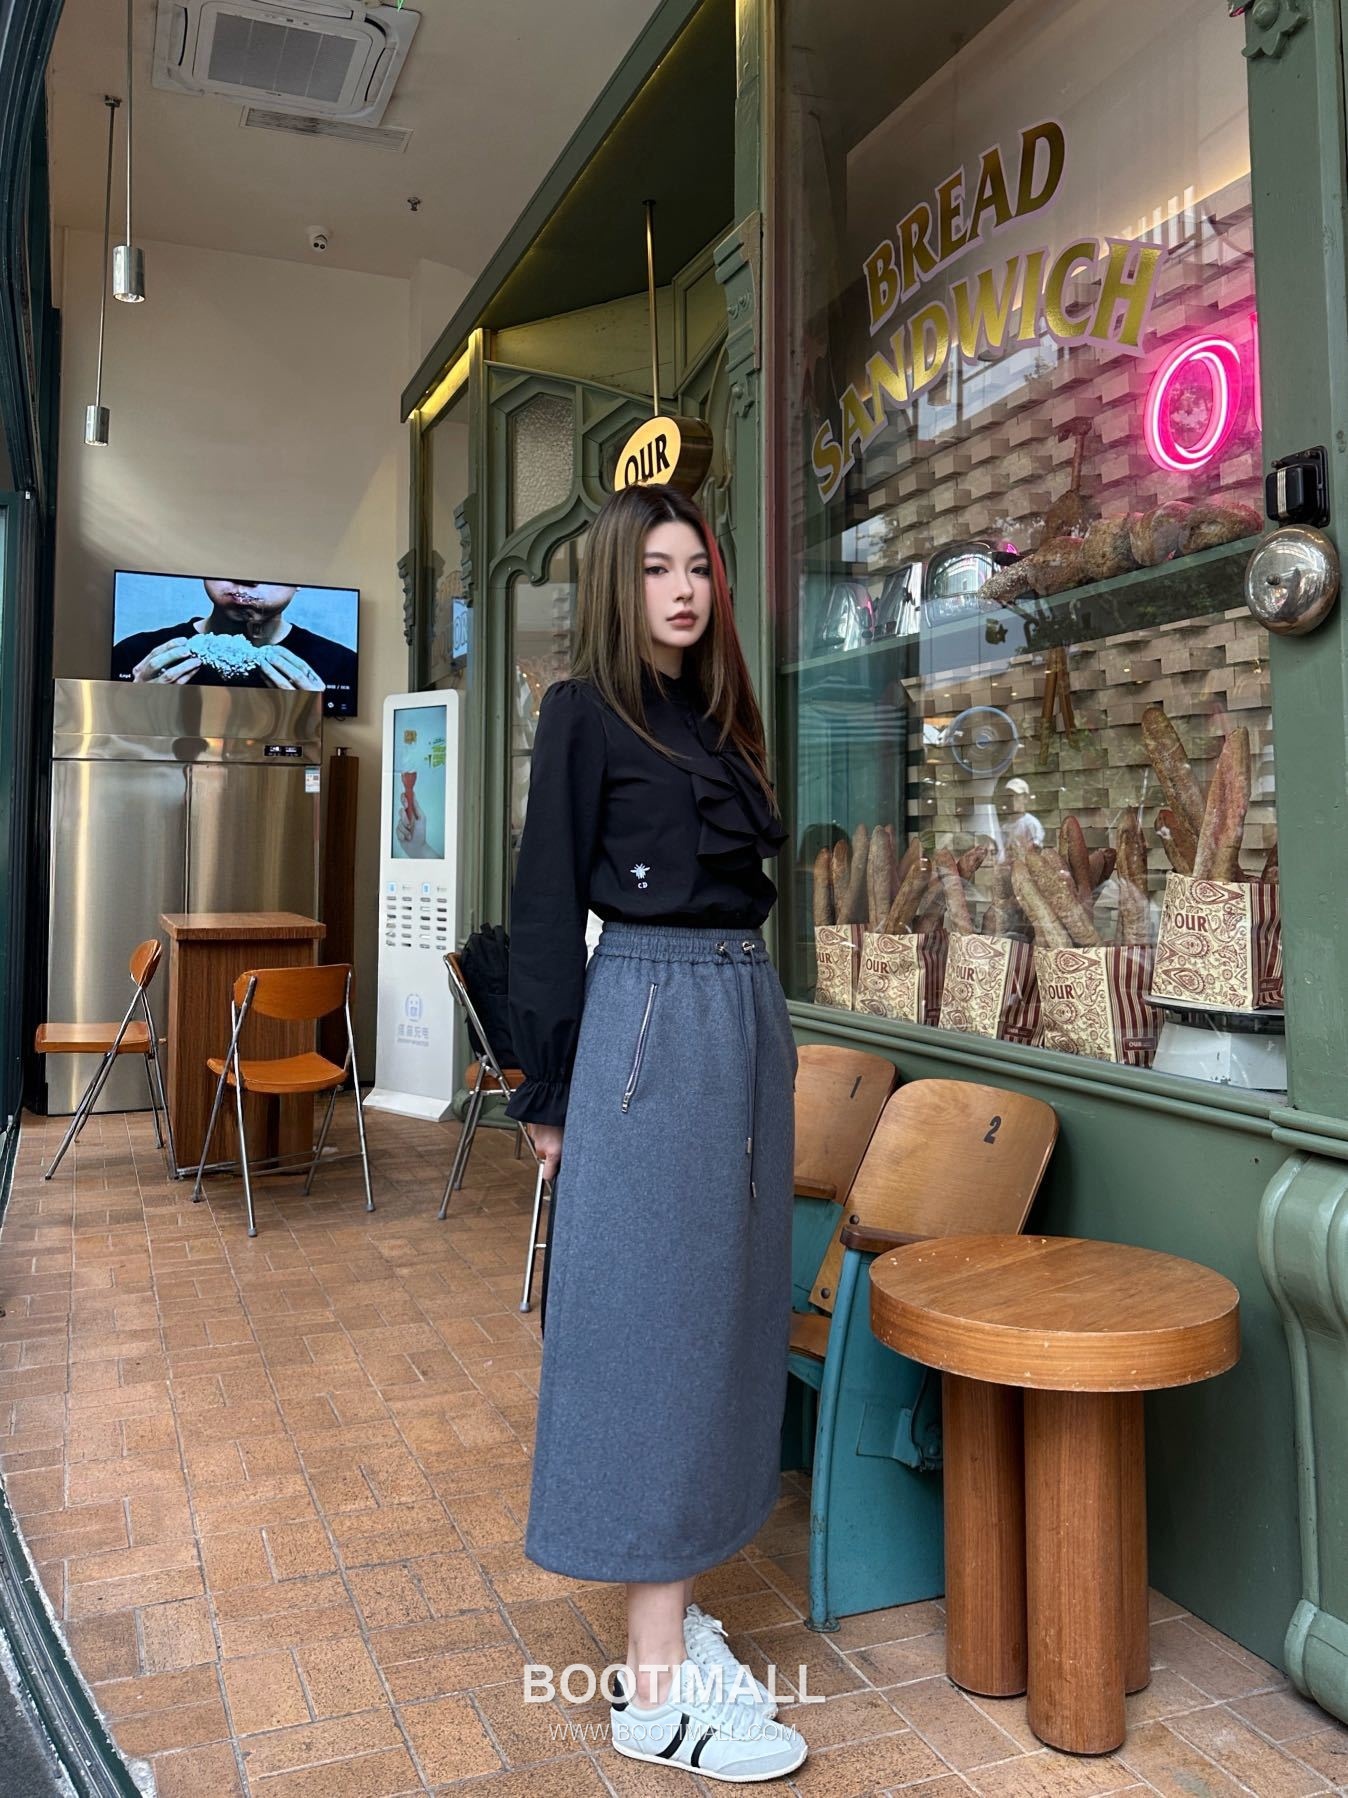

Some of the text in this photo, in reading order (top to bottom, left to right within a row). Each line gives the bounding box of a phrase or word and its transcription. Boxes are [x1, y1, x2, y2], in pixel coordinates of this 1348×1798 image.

[861, 120, 1066, 336] BREAD
[811, 236, 1169, 503] SANDWICH
[1143, 312, 1262, 472] O
[624, 433, 671, 486] OUR
[1174, 912, 1208, 932] OUR
[816, 952, 833, 964] UR
[865, 958, 890, 975] OUR
[1049, 983, 1075, 1000] OUR
[850, 1075, 863, 1099] 1
[984, 1115, 1002, 1144] 2
